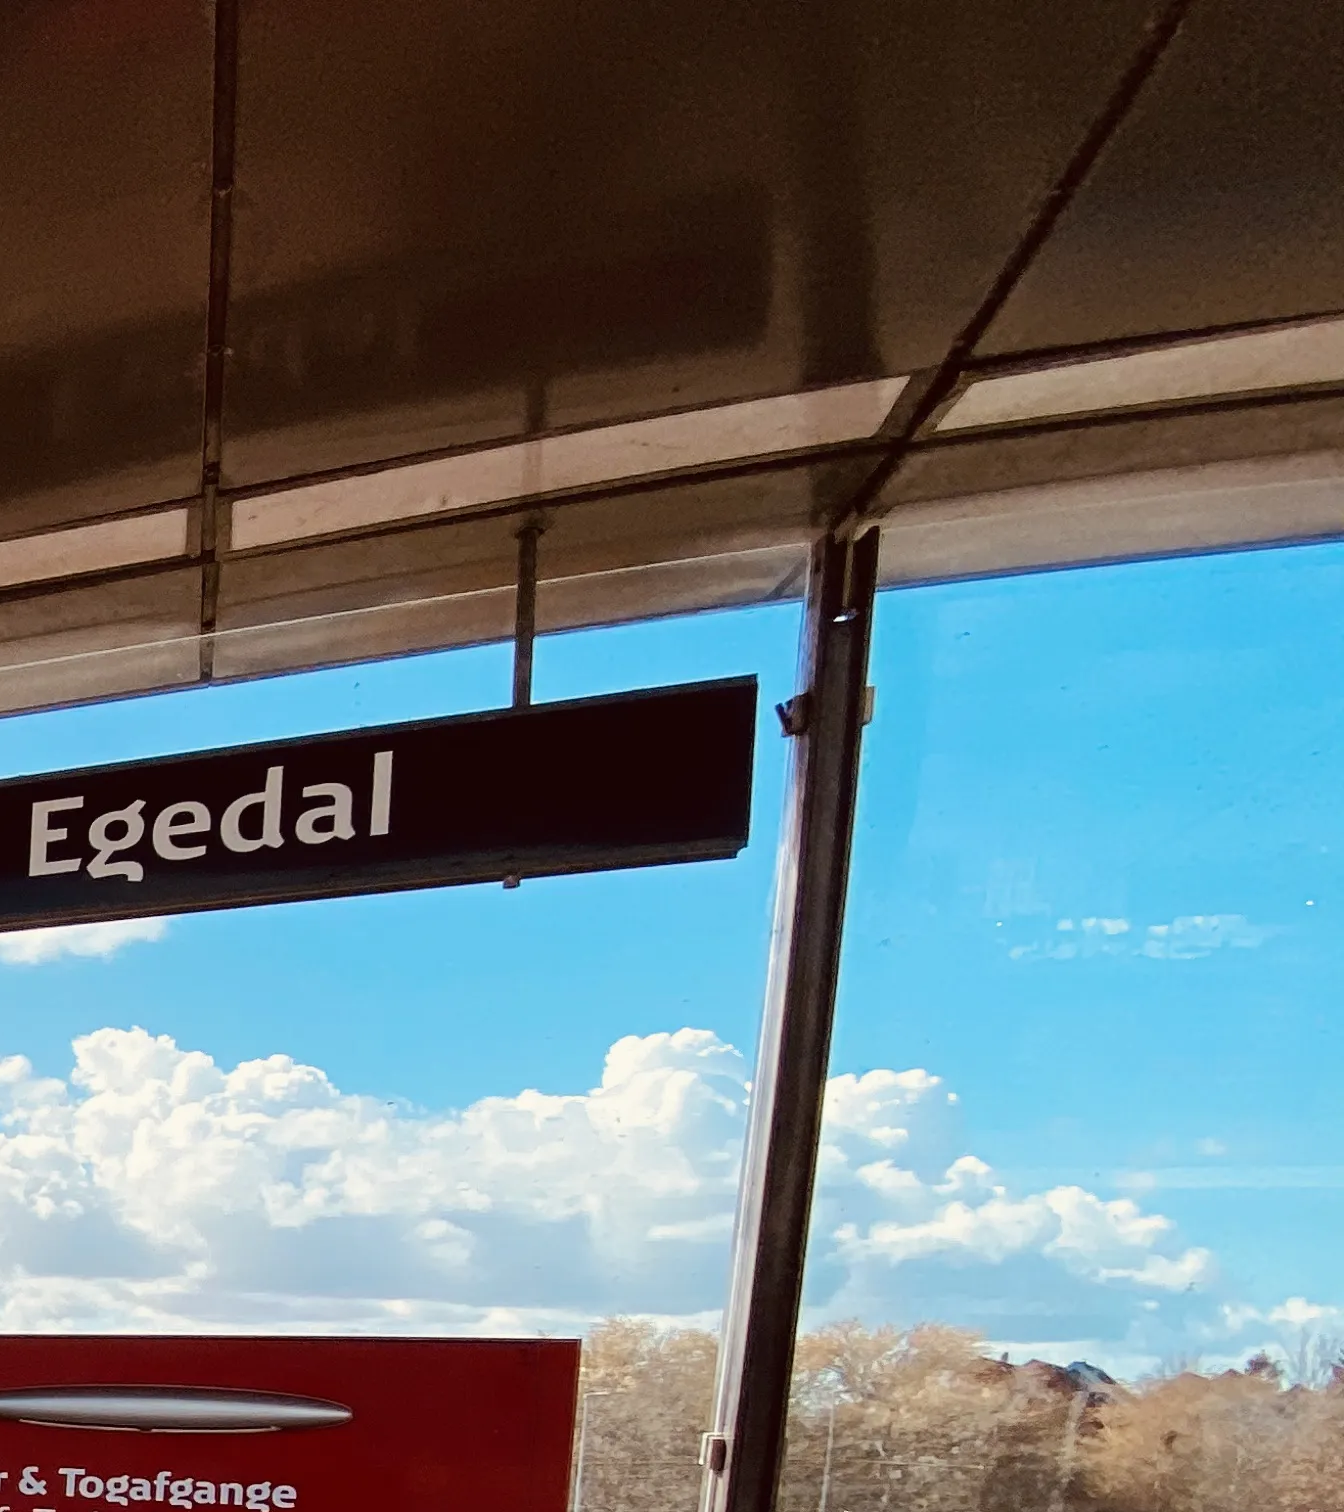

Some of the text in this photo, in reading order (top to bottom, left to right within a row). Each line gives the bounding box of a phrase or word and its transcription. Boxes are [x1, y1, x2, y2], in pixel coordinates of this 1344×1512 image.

[28, 751, 394, 882] Egedal
[18, 1466, 48, 1496] &
[58, 1467, 298, 1512] Togafgange
